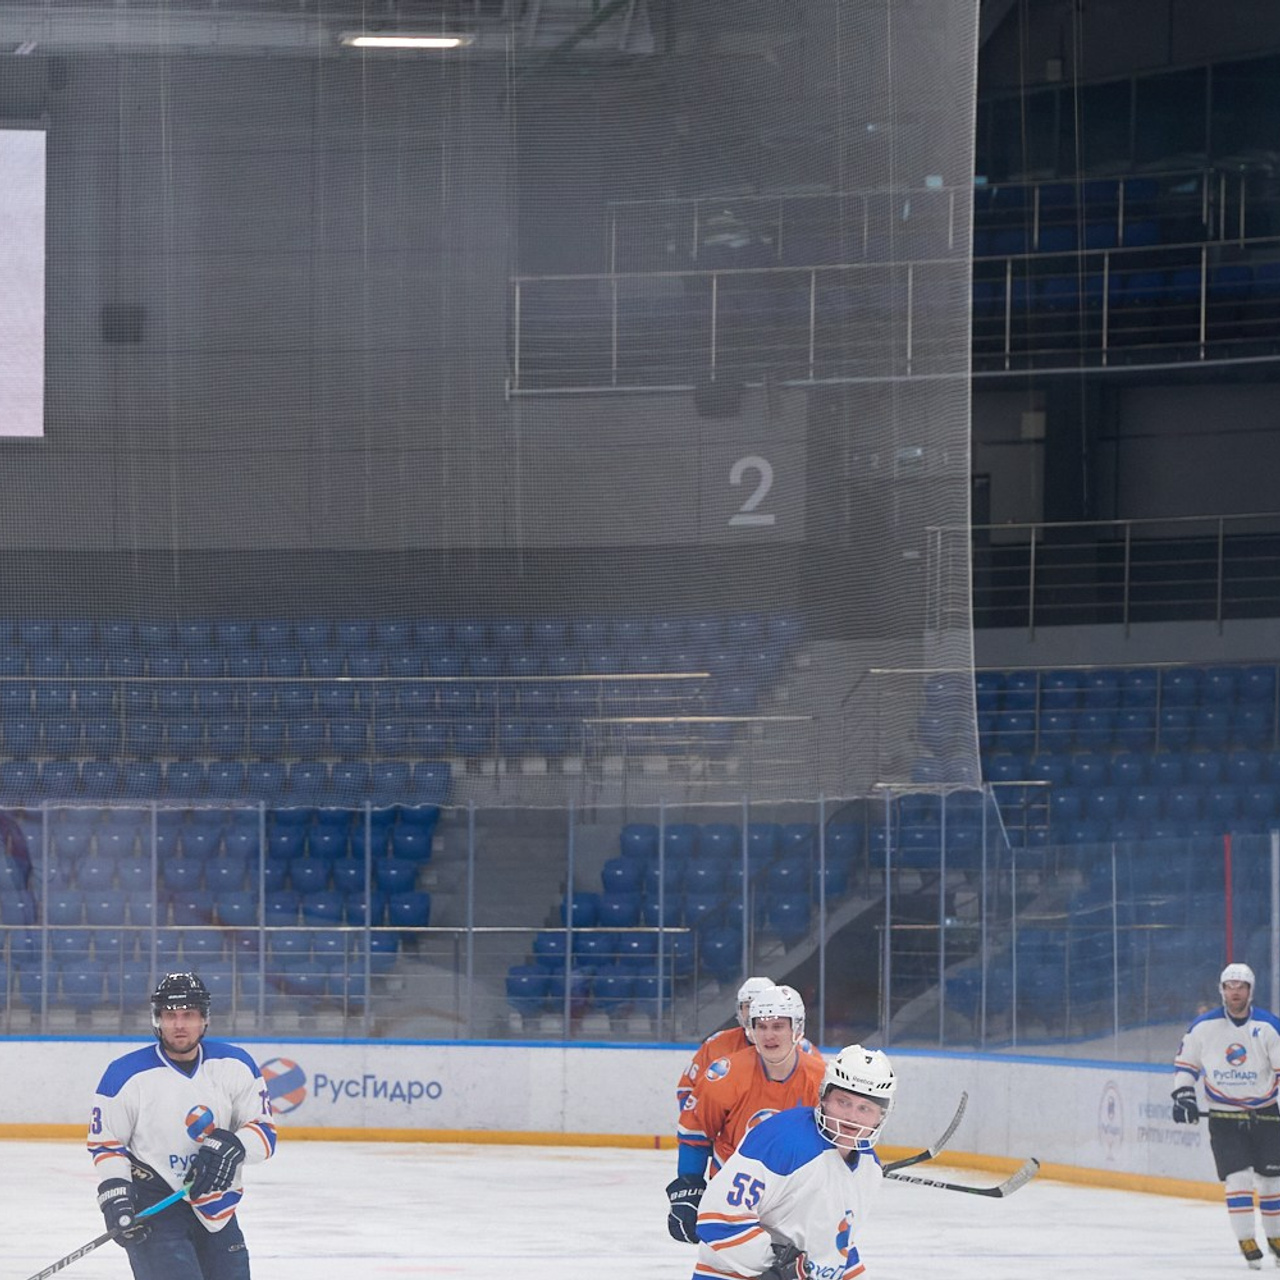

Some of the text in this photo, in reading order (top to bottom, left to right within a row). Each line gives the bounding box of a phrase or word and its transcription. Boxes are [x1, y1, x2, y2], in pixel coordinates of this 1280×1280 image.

[728, 455, 776, 526] 2
[314, 1074, 442, 1104] РусГидро
[726, 1172, 766, 1210] 55
